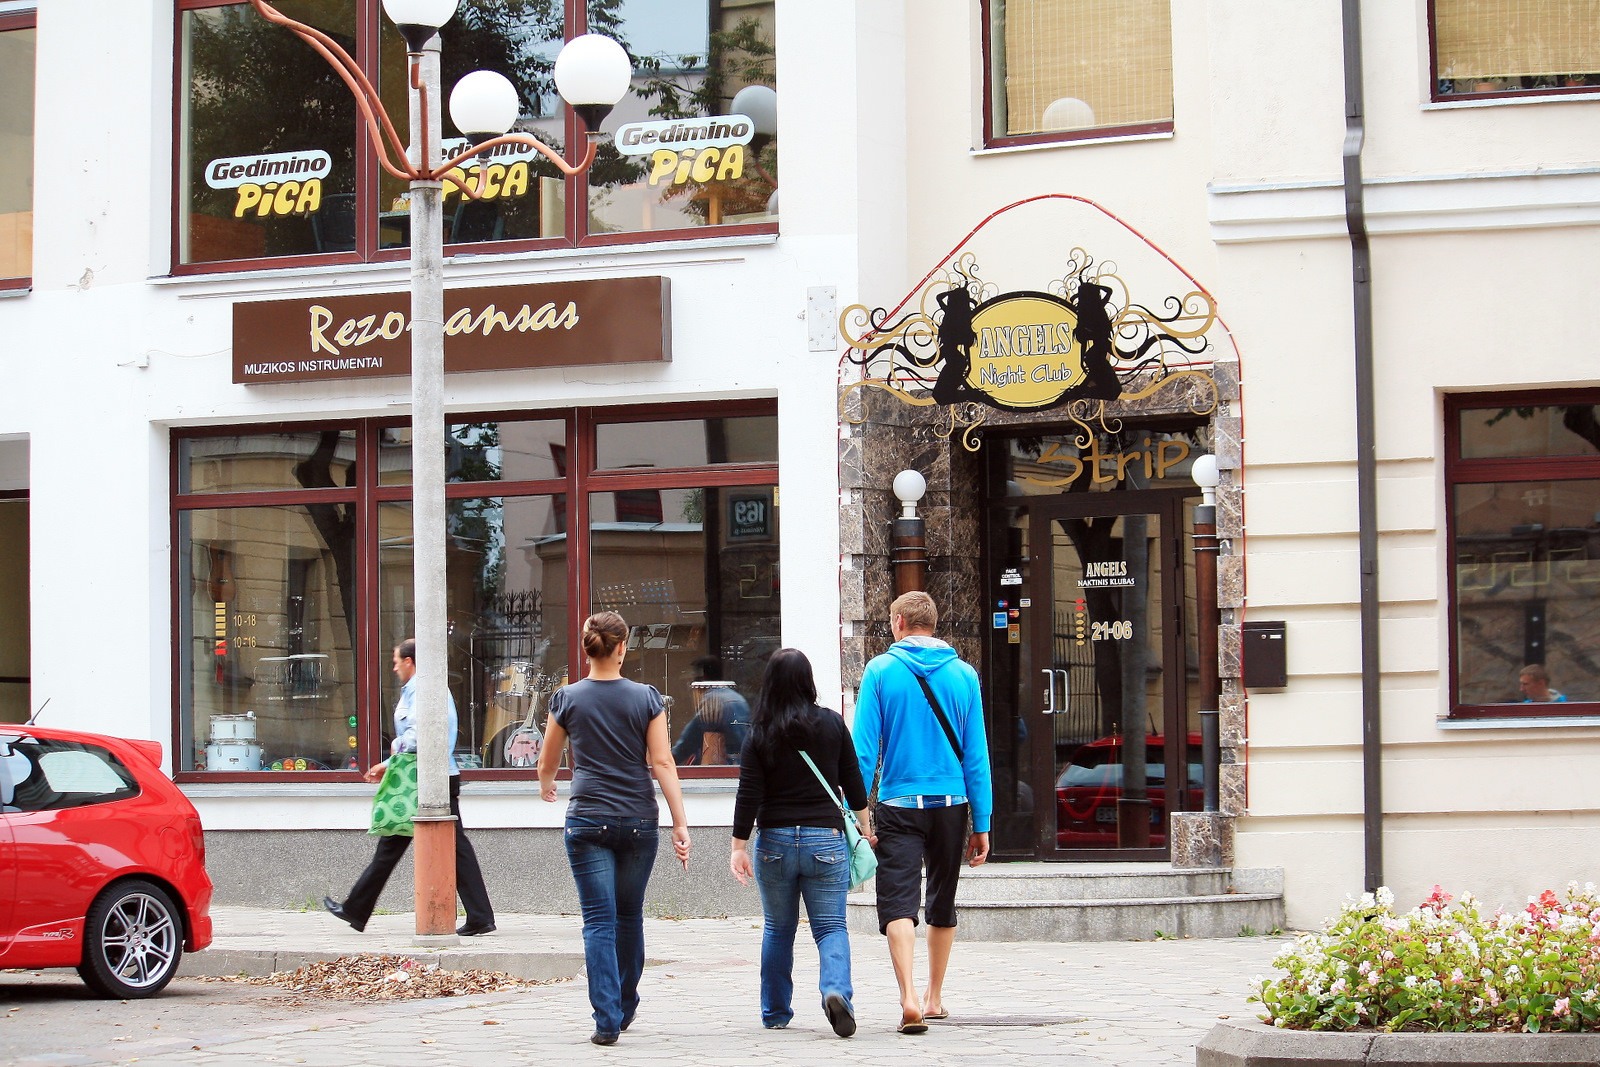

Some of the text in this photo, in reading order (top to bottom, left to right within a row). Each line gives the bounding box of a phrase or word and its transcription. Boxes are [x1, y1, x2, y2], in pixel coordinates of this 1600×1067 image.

[622, 121, 749, 146] Gedimino
[212, 156, 327, 180] Gedimino
[309, 301, 580, 355] Rezoansas
[979, 323, 1071, 358] ANGELS
[244, 357, 383, 375] MUZIKOS INSTRUMENTAI
[980, 363, 1072, 388] Night Club
[1086, 561, 1128, 578] ANGELS
[1077, 577, 1135, 587] NAKTINIS KLUBAS
[1091, 620, 1133, 640] 21-06
